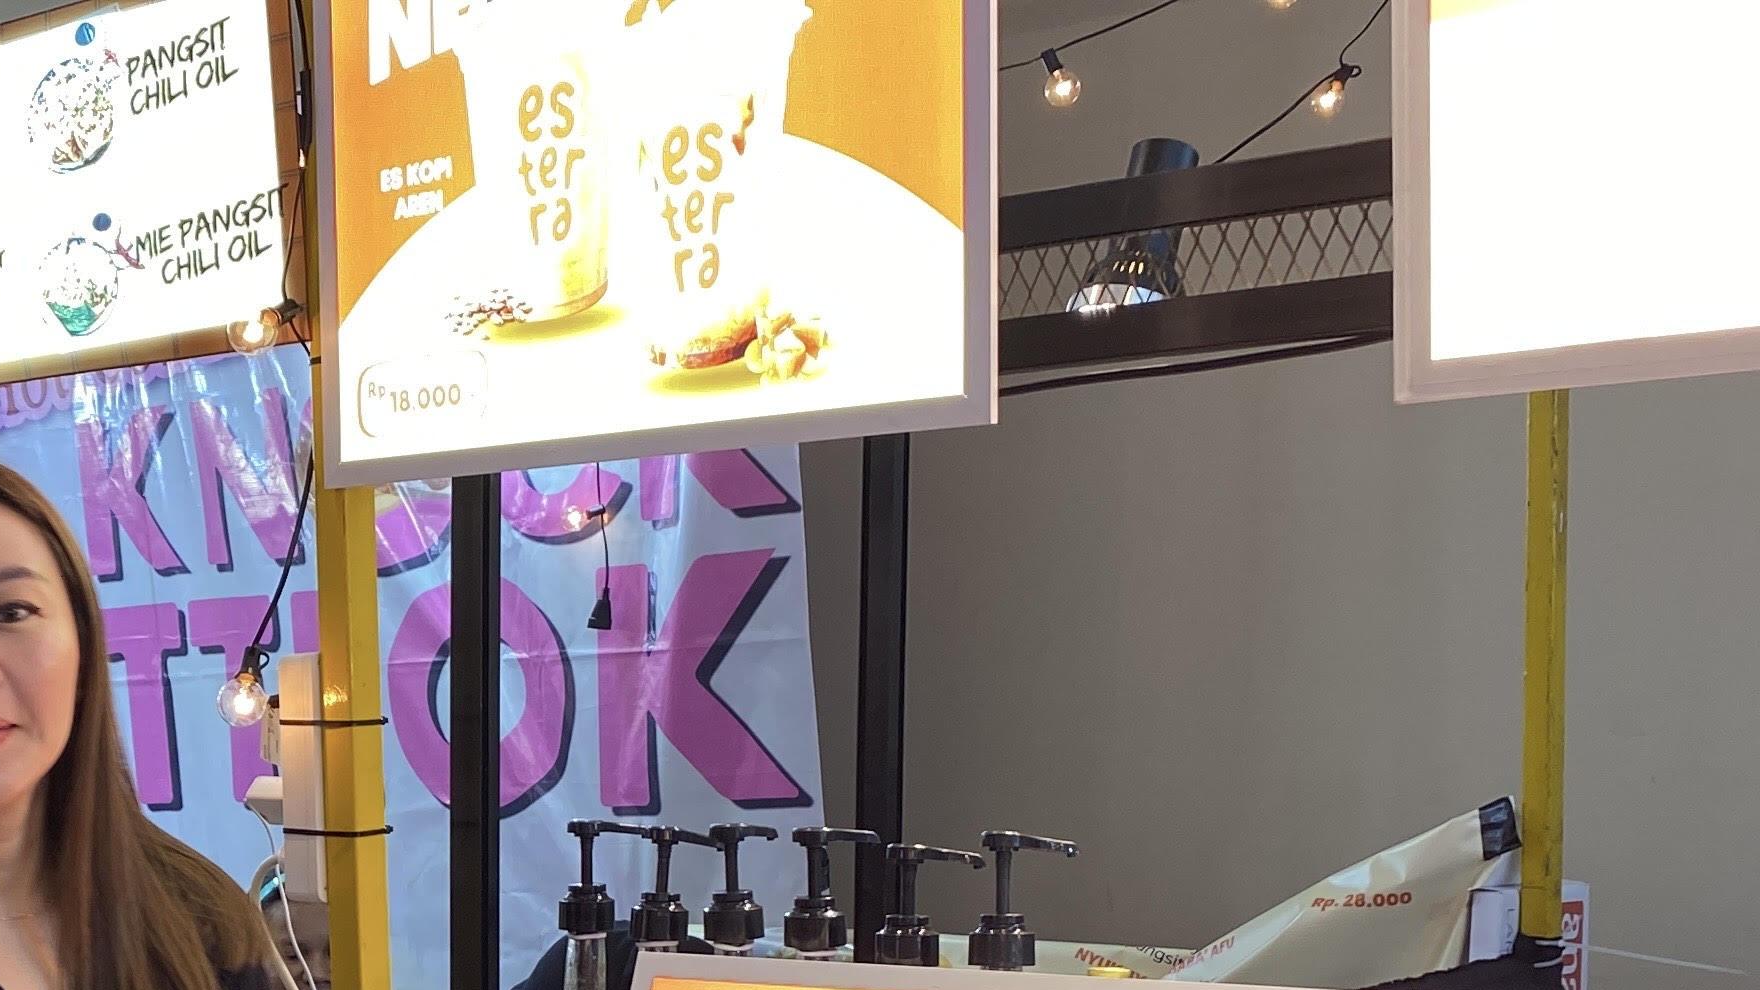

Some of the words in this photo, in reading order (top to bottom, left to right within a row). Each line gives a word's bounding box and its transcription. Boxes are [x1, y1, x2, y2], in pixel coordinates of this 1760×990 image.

[125, 16, 231, 87] PANGSIT
[130, 70, 188, 115] CHILI
[196, 55, 240, 89] OIL
[519, 81, 575, 142] es
[662, 122, 724, 186] es
[135, 225, 174, 261] MIE
[178, 181, 290, 248] PANGSIT
[162, 243, 220, 284] CHILI
[228, 230, 273, 262] OIL
[367, 382, 387, 401] Rp
[390, 384, 461, 413] 18.000
[106, 546, 813, 815] TTOK
[1311, 897, 1339, 912] Rp.
[1342, 892, 1413, 908] 28.000
